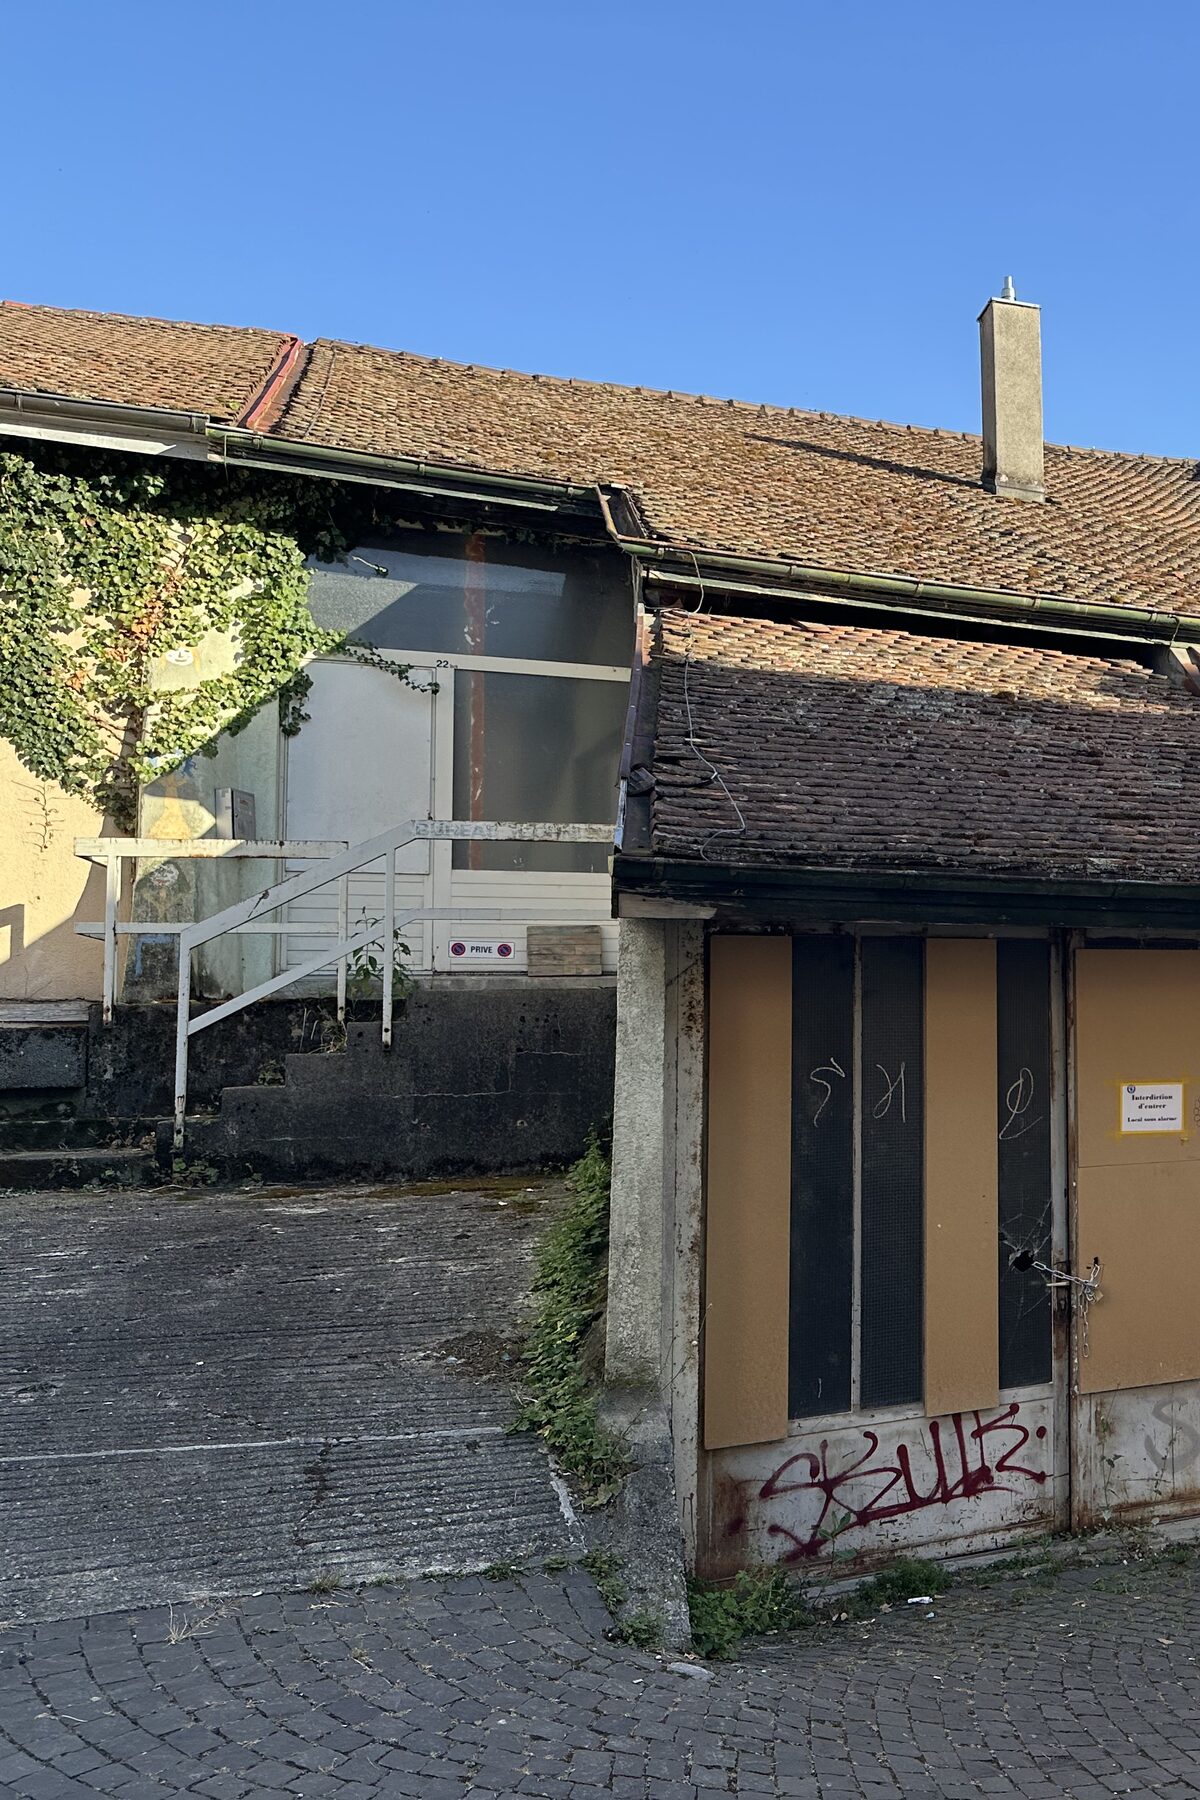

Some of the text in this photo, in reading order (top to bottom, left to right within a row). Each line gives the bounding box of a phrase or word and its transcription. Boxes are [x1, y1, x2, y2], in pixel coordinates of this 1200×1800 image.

[436, 659, 449, 669] 22
[470, 945, 493, 954] PRIVE
[1131, 1094, 1174, 1102] Interdiction
